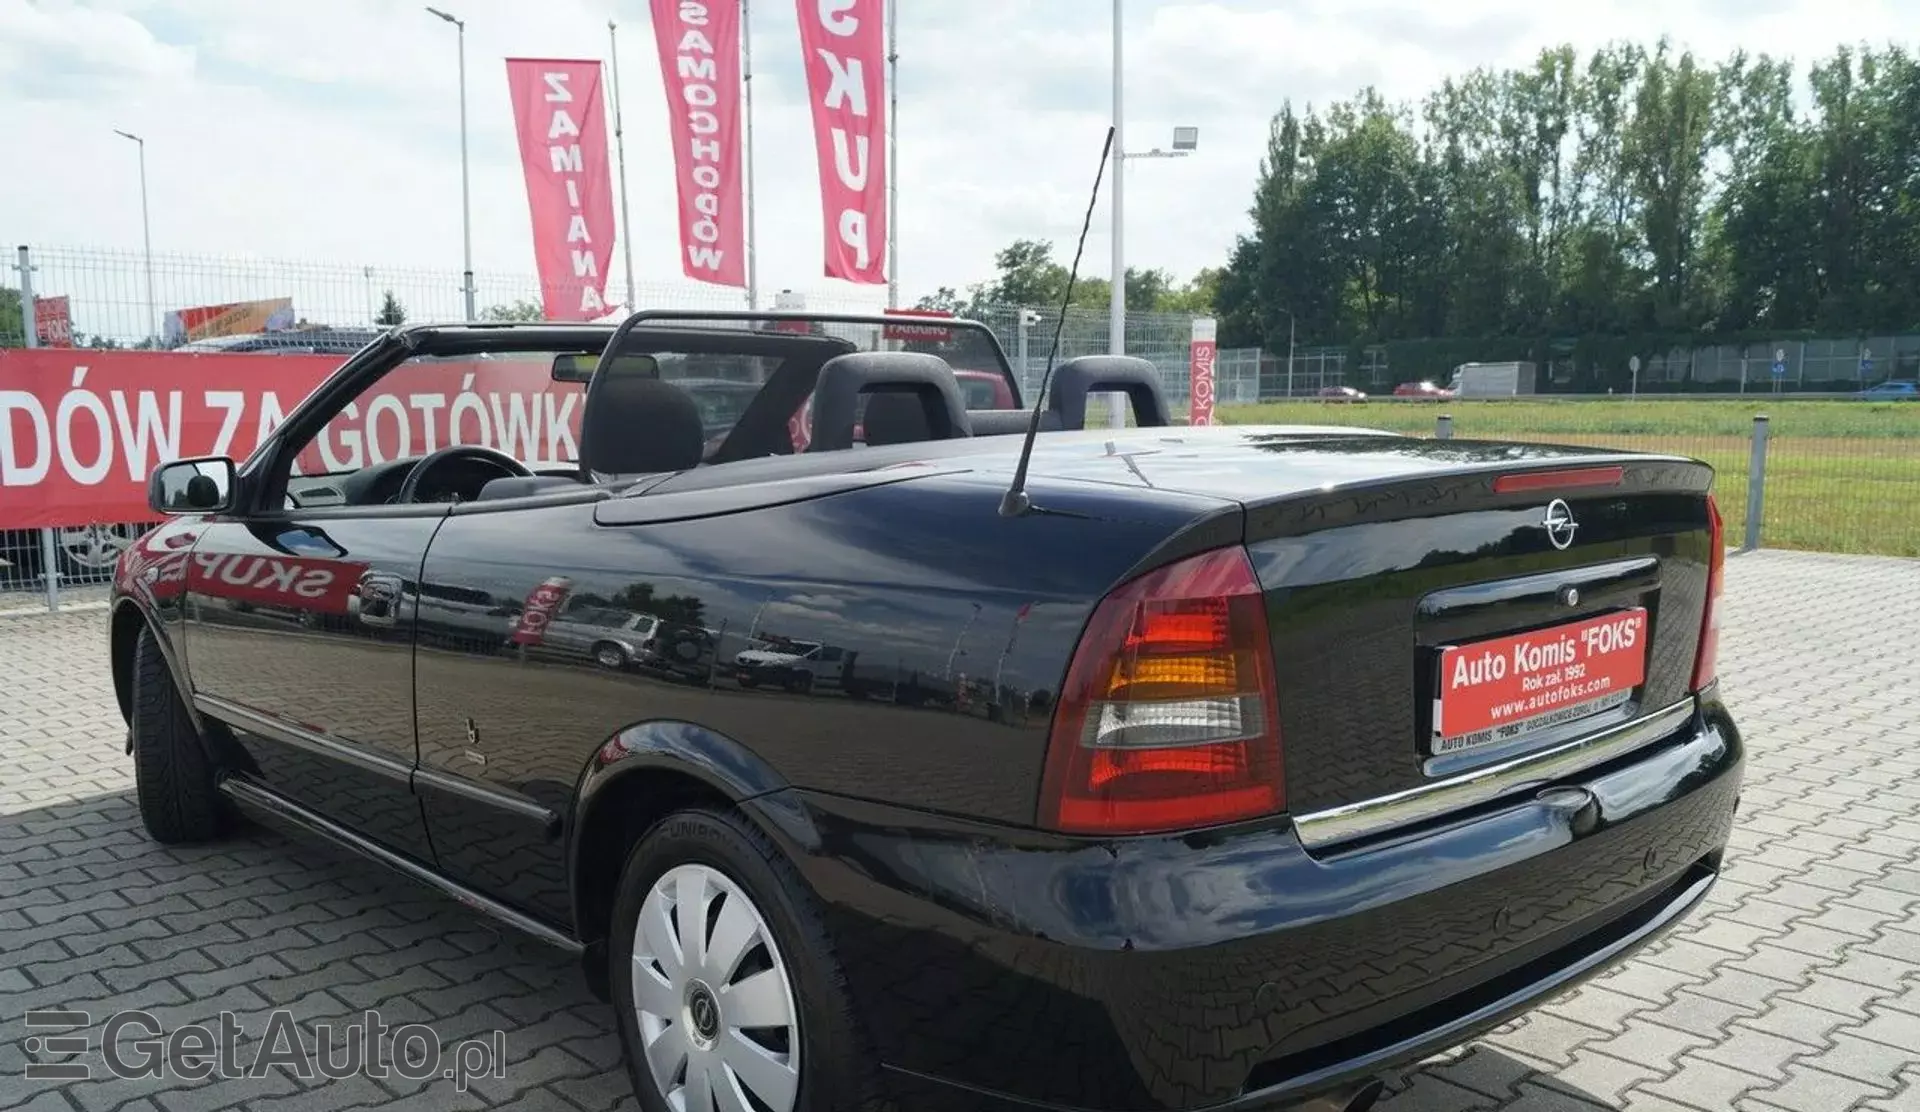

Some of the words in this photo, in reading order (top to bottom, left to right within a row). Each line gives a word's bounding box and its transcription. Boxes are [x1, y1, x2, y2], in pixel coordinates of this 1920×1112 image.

[1196, 346, 1210, 410] KOMIS
[317, 373, 587, 476] GOTÓWK
[1452, 650, 1506, 690] Auto
[1514, 634, 1576, 675] Komis
[1581, 616, 1642, 657] "FOKS"
[1522, 675, 1543, 692] Rok
[1565, 663, 1586, 681] 1992
[1491, 676, 1611, 720] www.autofoks.com
[1441, 737, 1464, 750] AUTO
[1465, 730, 1492, 747] KOMIS
